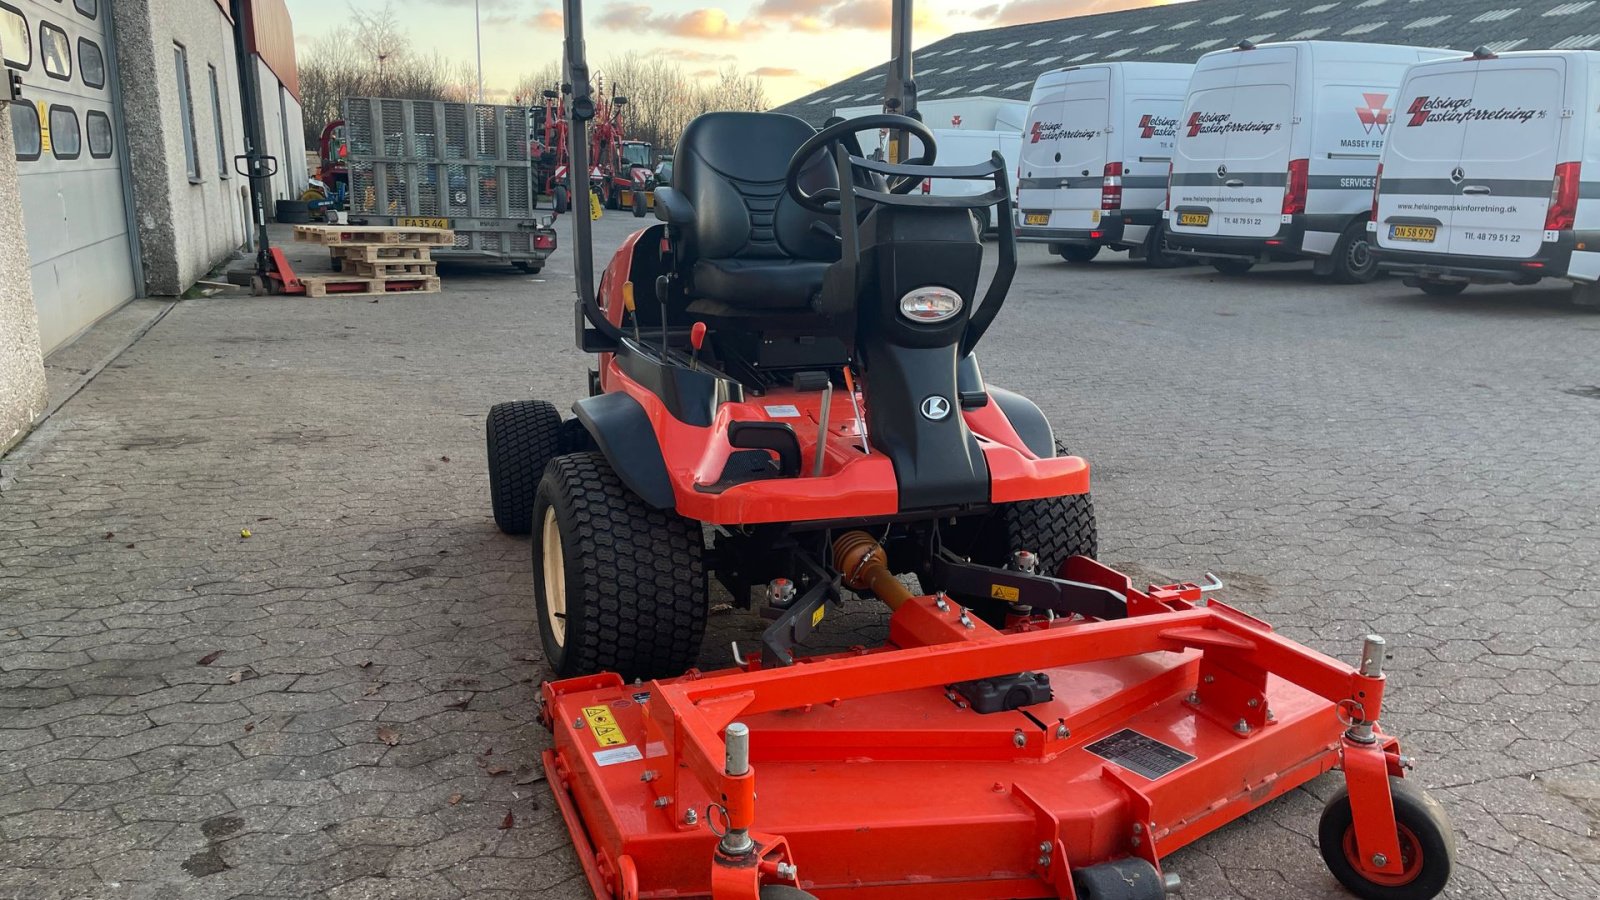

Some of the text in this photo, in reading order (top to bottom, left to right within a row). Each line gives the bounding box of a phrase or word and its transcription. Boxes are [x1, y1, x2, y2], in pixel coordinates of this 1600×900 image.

[1340, 139, 1370, 148] MASSEY
[1340, 178, 1371, 188] SERVICE
[1397, 203, 1518, 215] www.helsingemaskinforretning.dk
[1476, 232, 1486, 241] 48
[1488, 233, 1498, 241] 79
[1499, 233, 1508, 242] 51
[1510, 234, 1521, 243] 22
